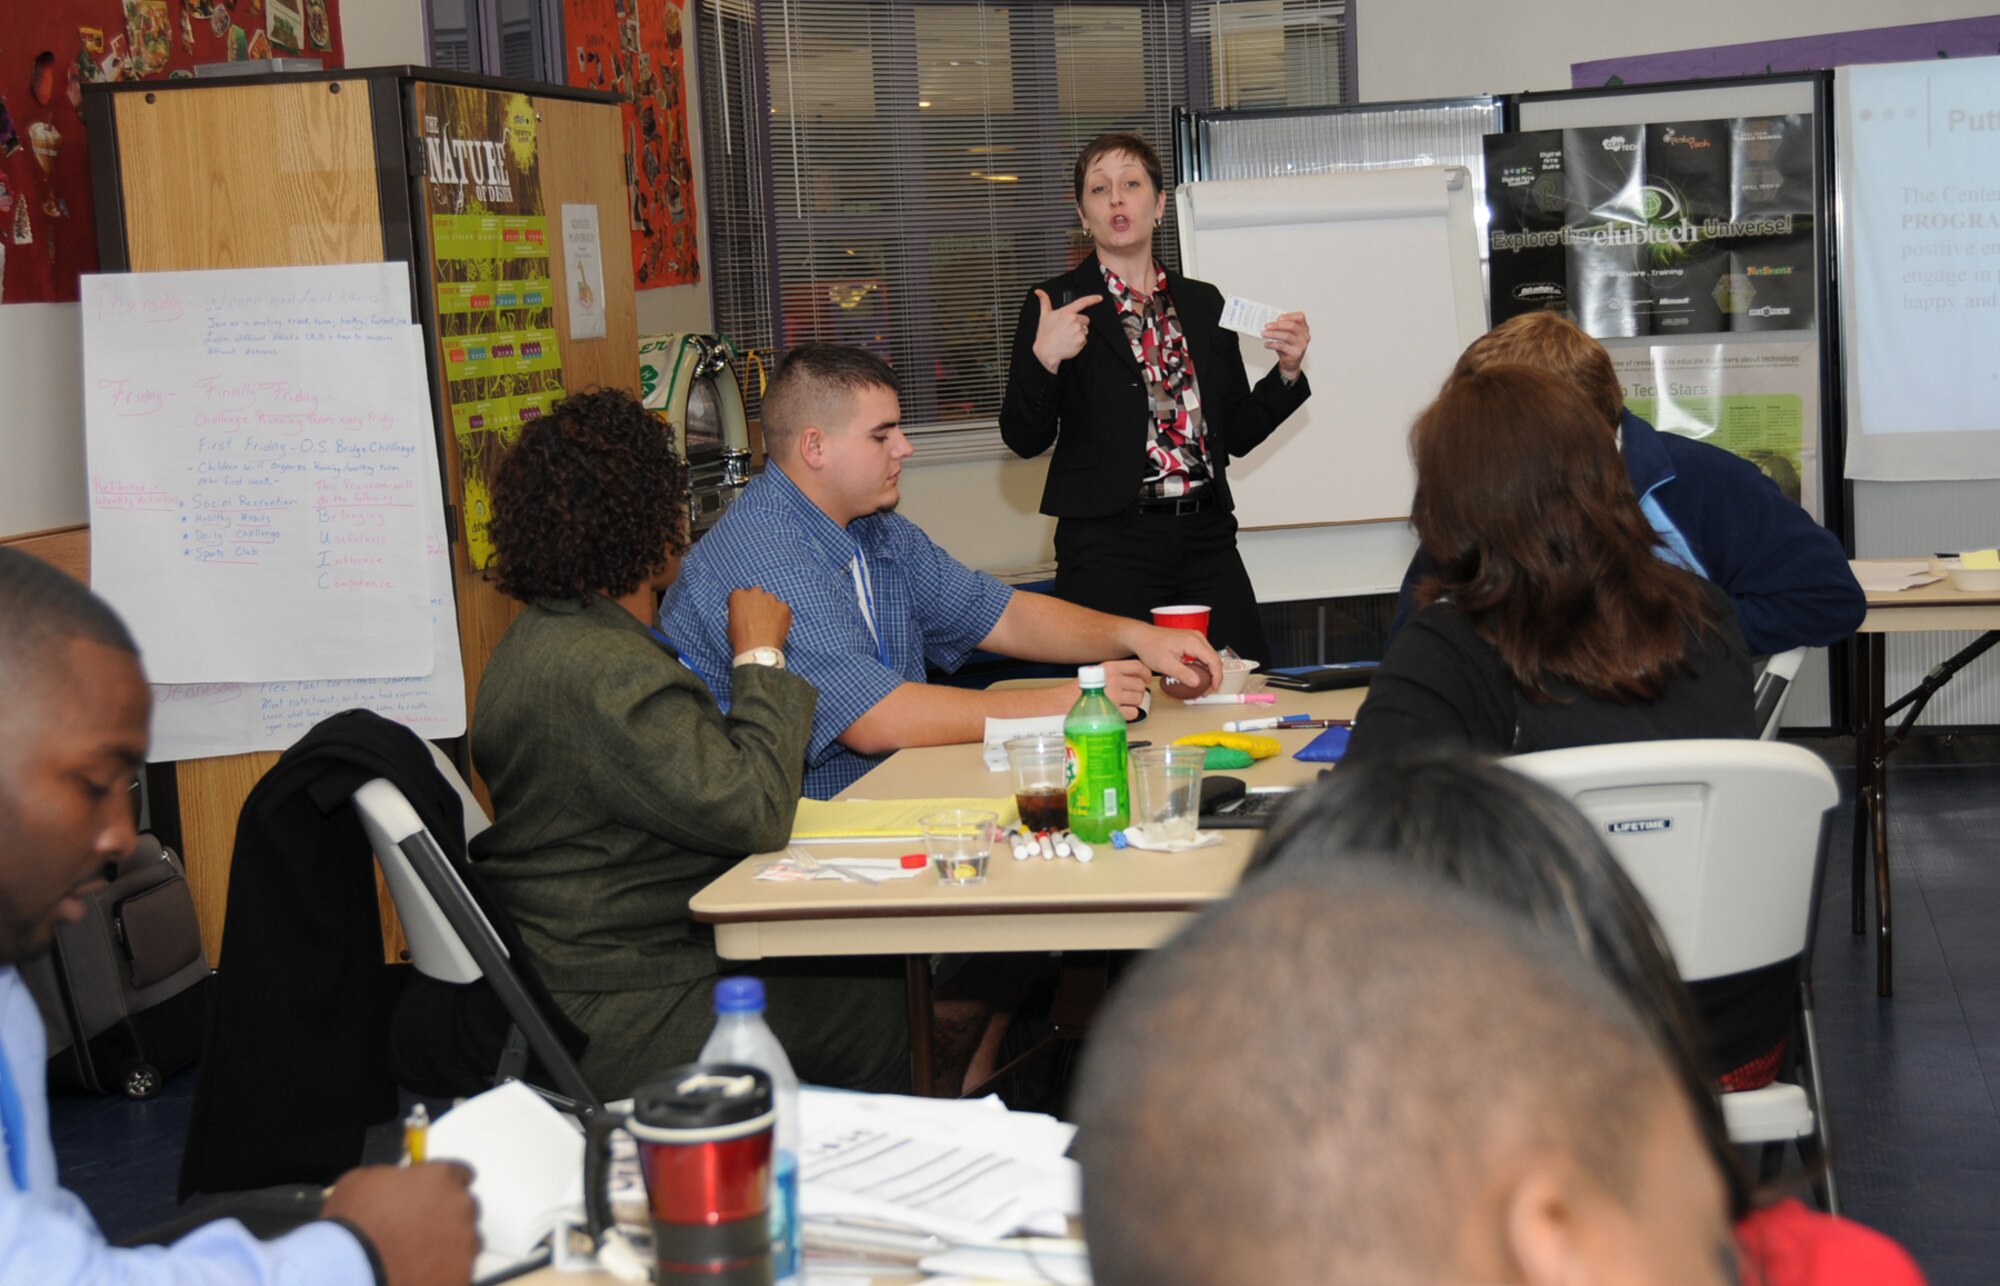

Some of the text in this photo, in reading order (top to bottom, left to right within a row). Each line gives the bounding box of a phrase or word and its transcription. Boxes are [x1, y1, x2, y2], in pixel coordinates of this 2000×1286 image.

[427, 128, 511, 186] NATURE
[1901, 187, 1936, 204] The
[1491, 213, 1793, 253] Explore the clubtech Universe!
[1901, 240, 1977, 262] positive
[1651, 268, 1684, 277] Training
[1902, 265, 1992, 286] engage in
[1902, 289, 1997, 313] happy and
[1668, 358, 1676, 366] to
[1676, 357, 1704, 366] educate
[1740, 355, 1760, 364] about
[1761, 354, 1800, 365] technology
[98, 374, 320, 417] Friday Finally Friday
[1668, 382, 1708, 396] Stars
[194, 413, 250, 434] Challenge
[255, 411, 304, 437] Running
[198, 436, 233, 453] First
[243, 436, 287, 463] Friday
[335, 438, 368, 458] Bridge
[368, 439, 417, 458] Challenge
[197, 461, 239, 474] Children
[242, 460, 264, 470] will
[191, 493, 298, 509] Social Recreation
[316, 508, 385, 527] Belonging
[195, 546, 259, 560] Sports Club
[315, 550, 385, 568] Influence
[1613, 819, 1666, 833] LIFETIME
